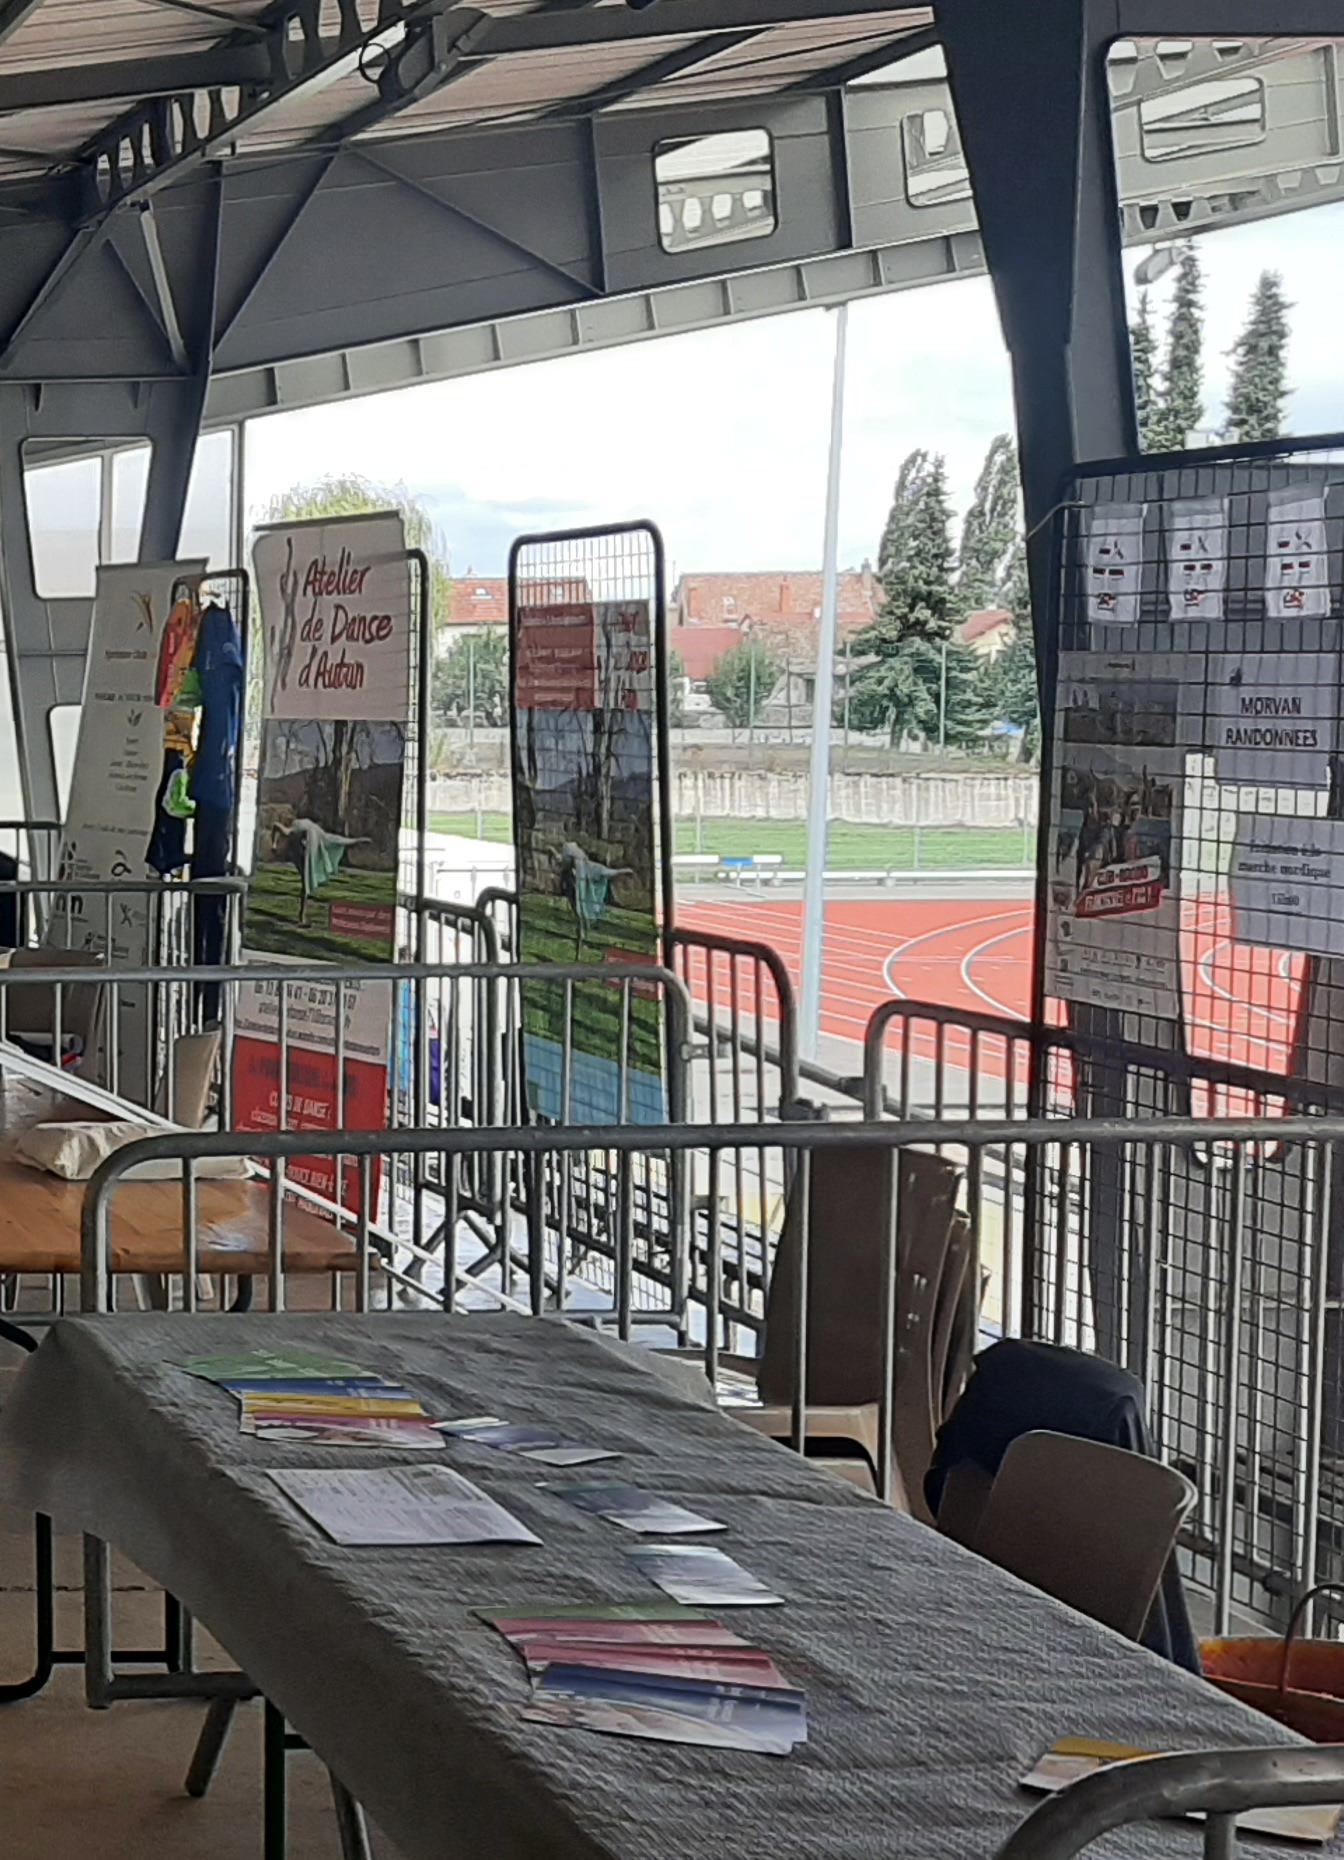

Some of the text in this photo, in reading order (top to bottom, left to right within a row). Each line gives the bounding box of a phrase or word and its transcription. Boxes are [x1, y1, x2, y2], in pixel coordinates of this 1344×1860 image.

[302, 546, 372, 598] Atelier
[300, 599, 393, 646] de Danse
[1240, 696, 1302, 715] MORVAN
